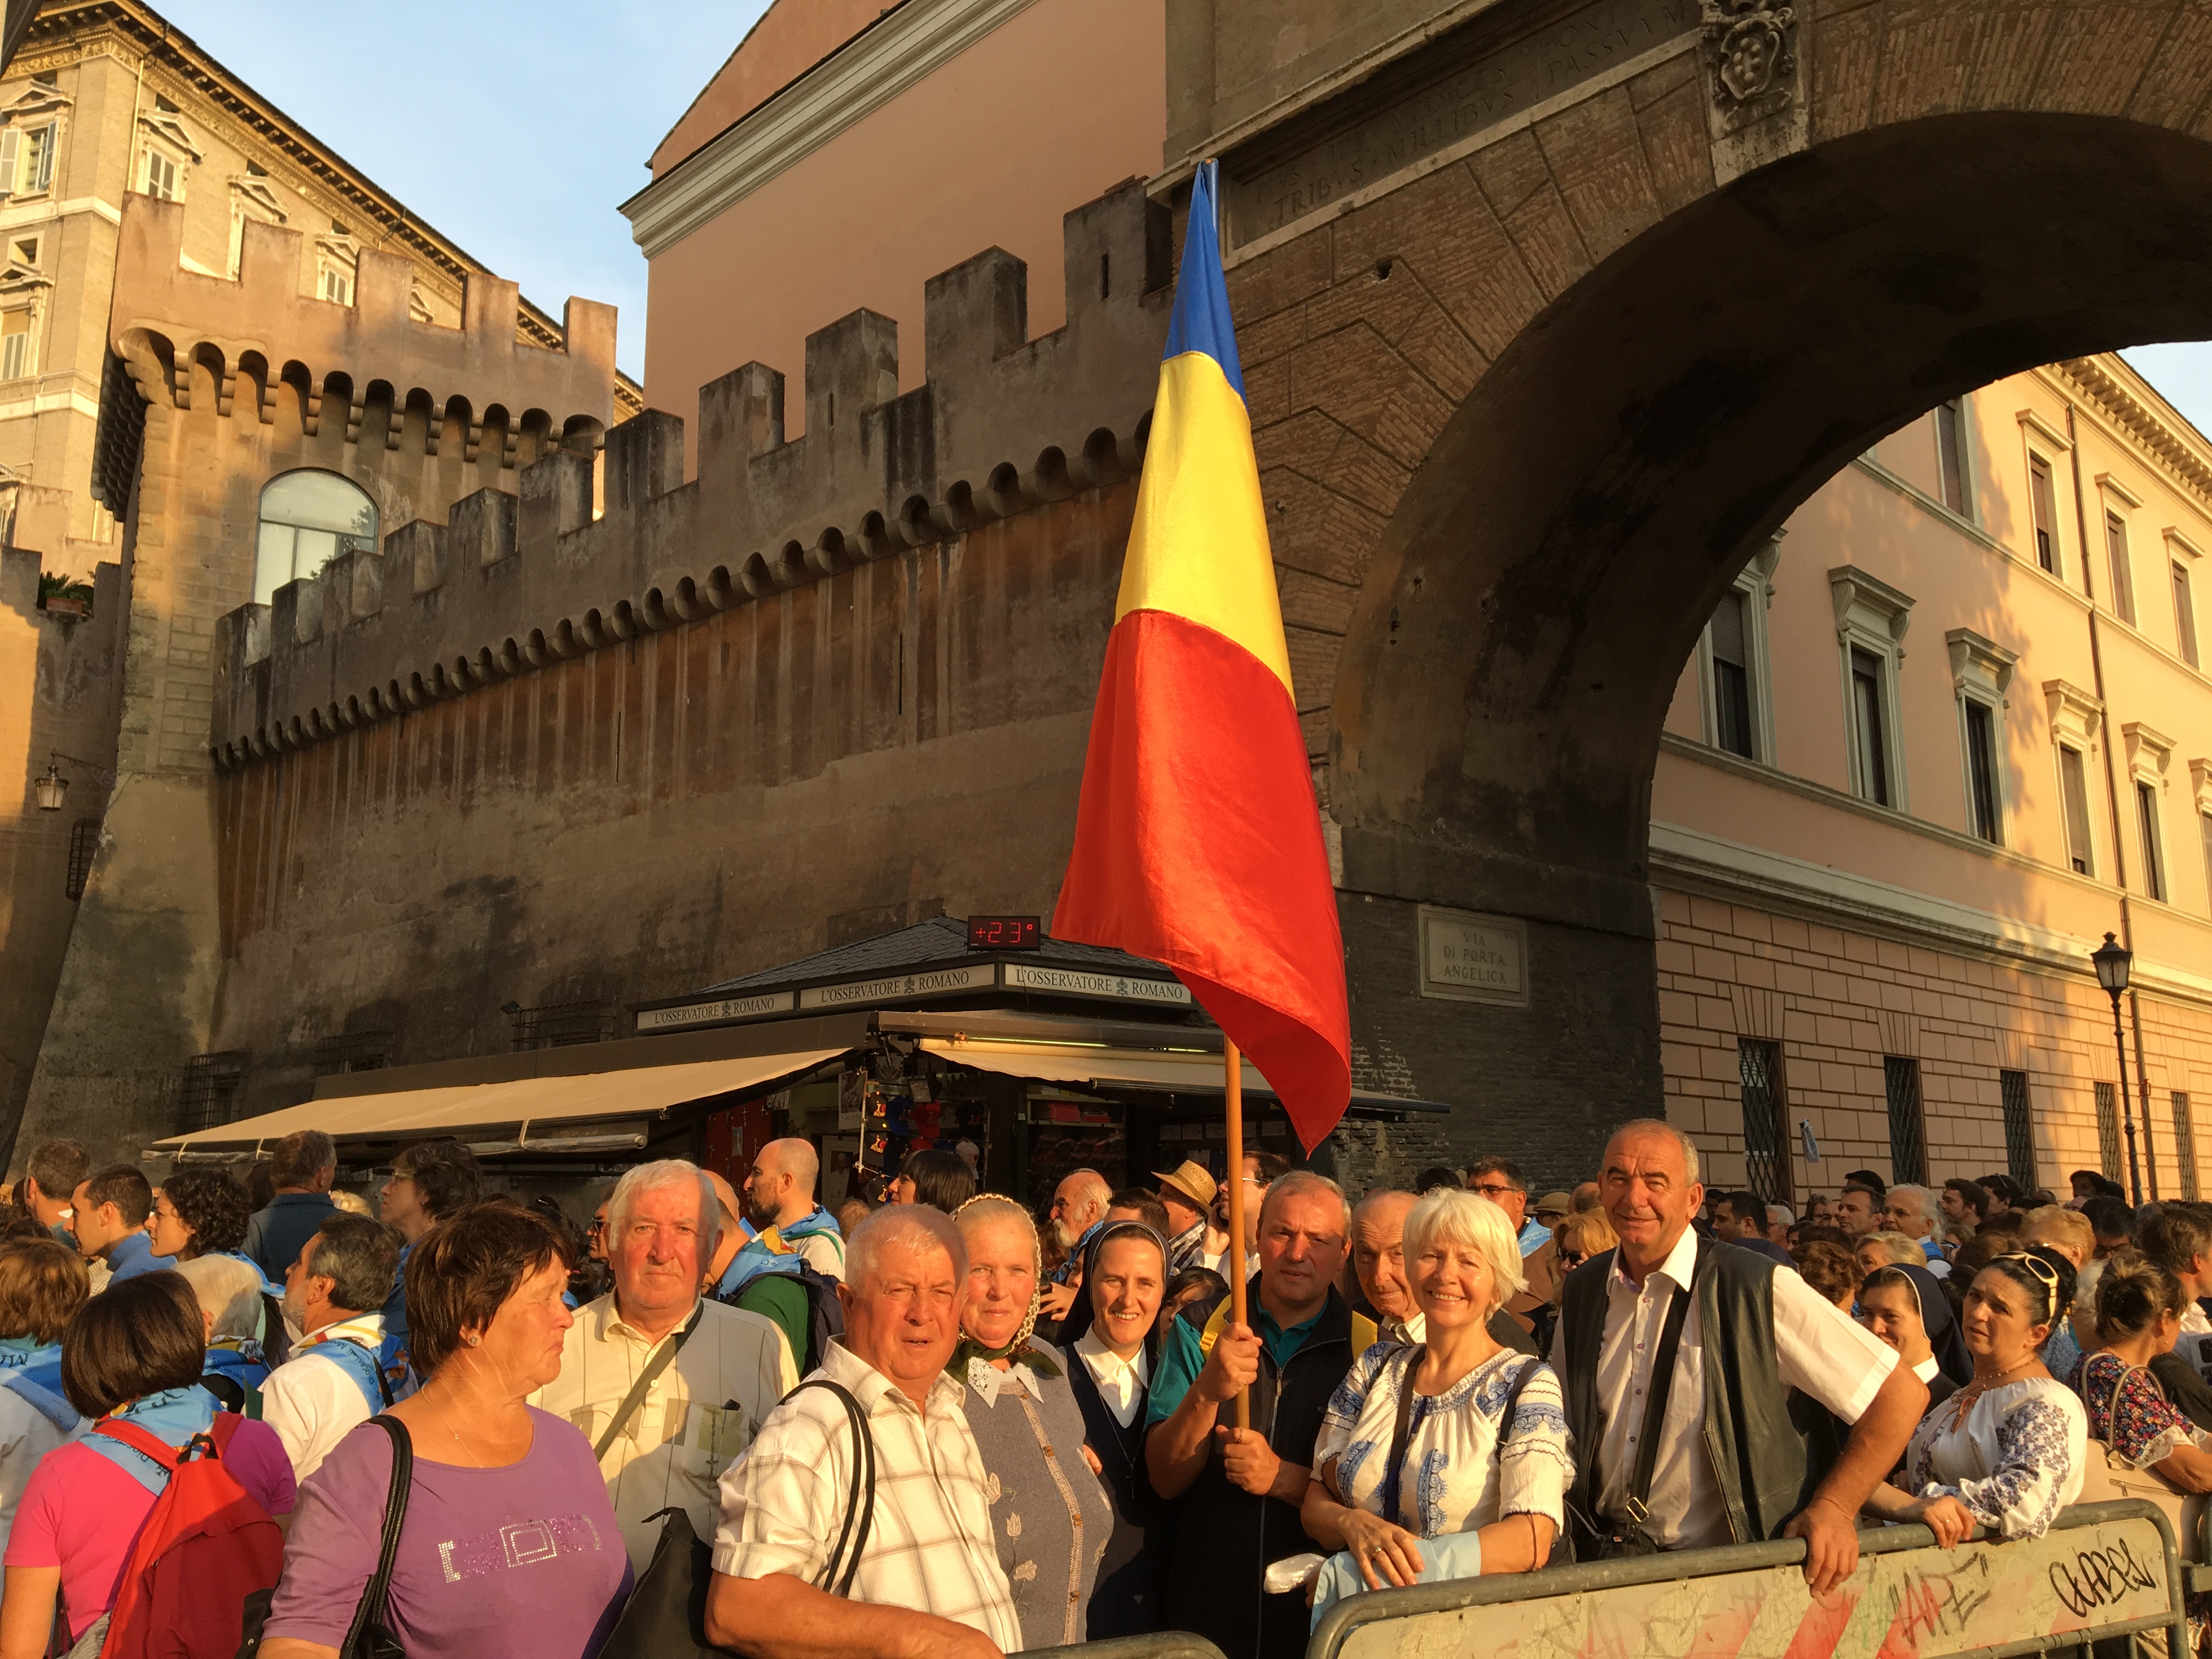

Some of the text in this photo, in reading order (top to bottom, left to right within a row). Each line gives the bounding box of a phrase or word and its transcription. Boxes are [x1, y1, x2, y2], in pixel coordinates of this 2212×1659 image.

[1273, 157, 1363, 222] TRIBVS
[1463, 932, 1486, 946] VIA
[1443, 945, 1506, 966] DI PORTA
[821, 970, 969, 1003] L'OSSERVATORE ROMANO
[1017, 969, 1183, 1000] L'OSSERVATORE ROMANO
[1444, 966, 1506, 983] ANGELICA
[654, 997, 774, 1024] L'OSSERVATORE ROMANO
